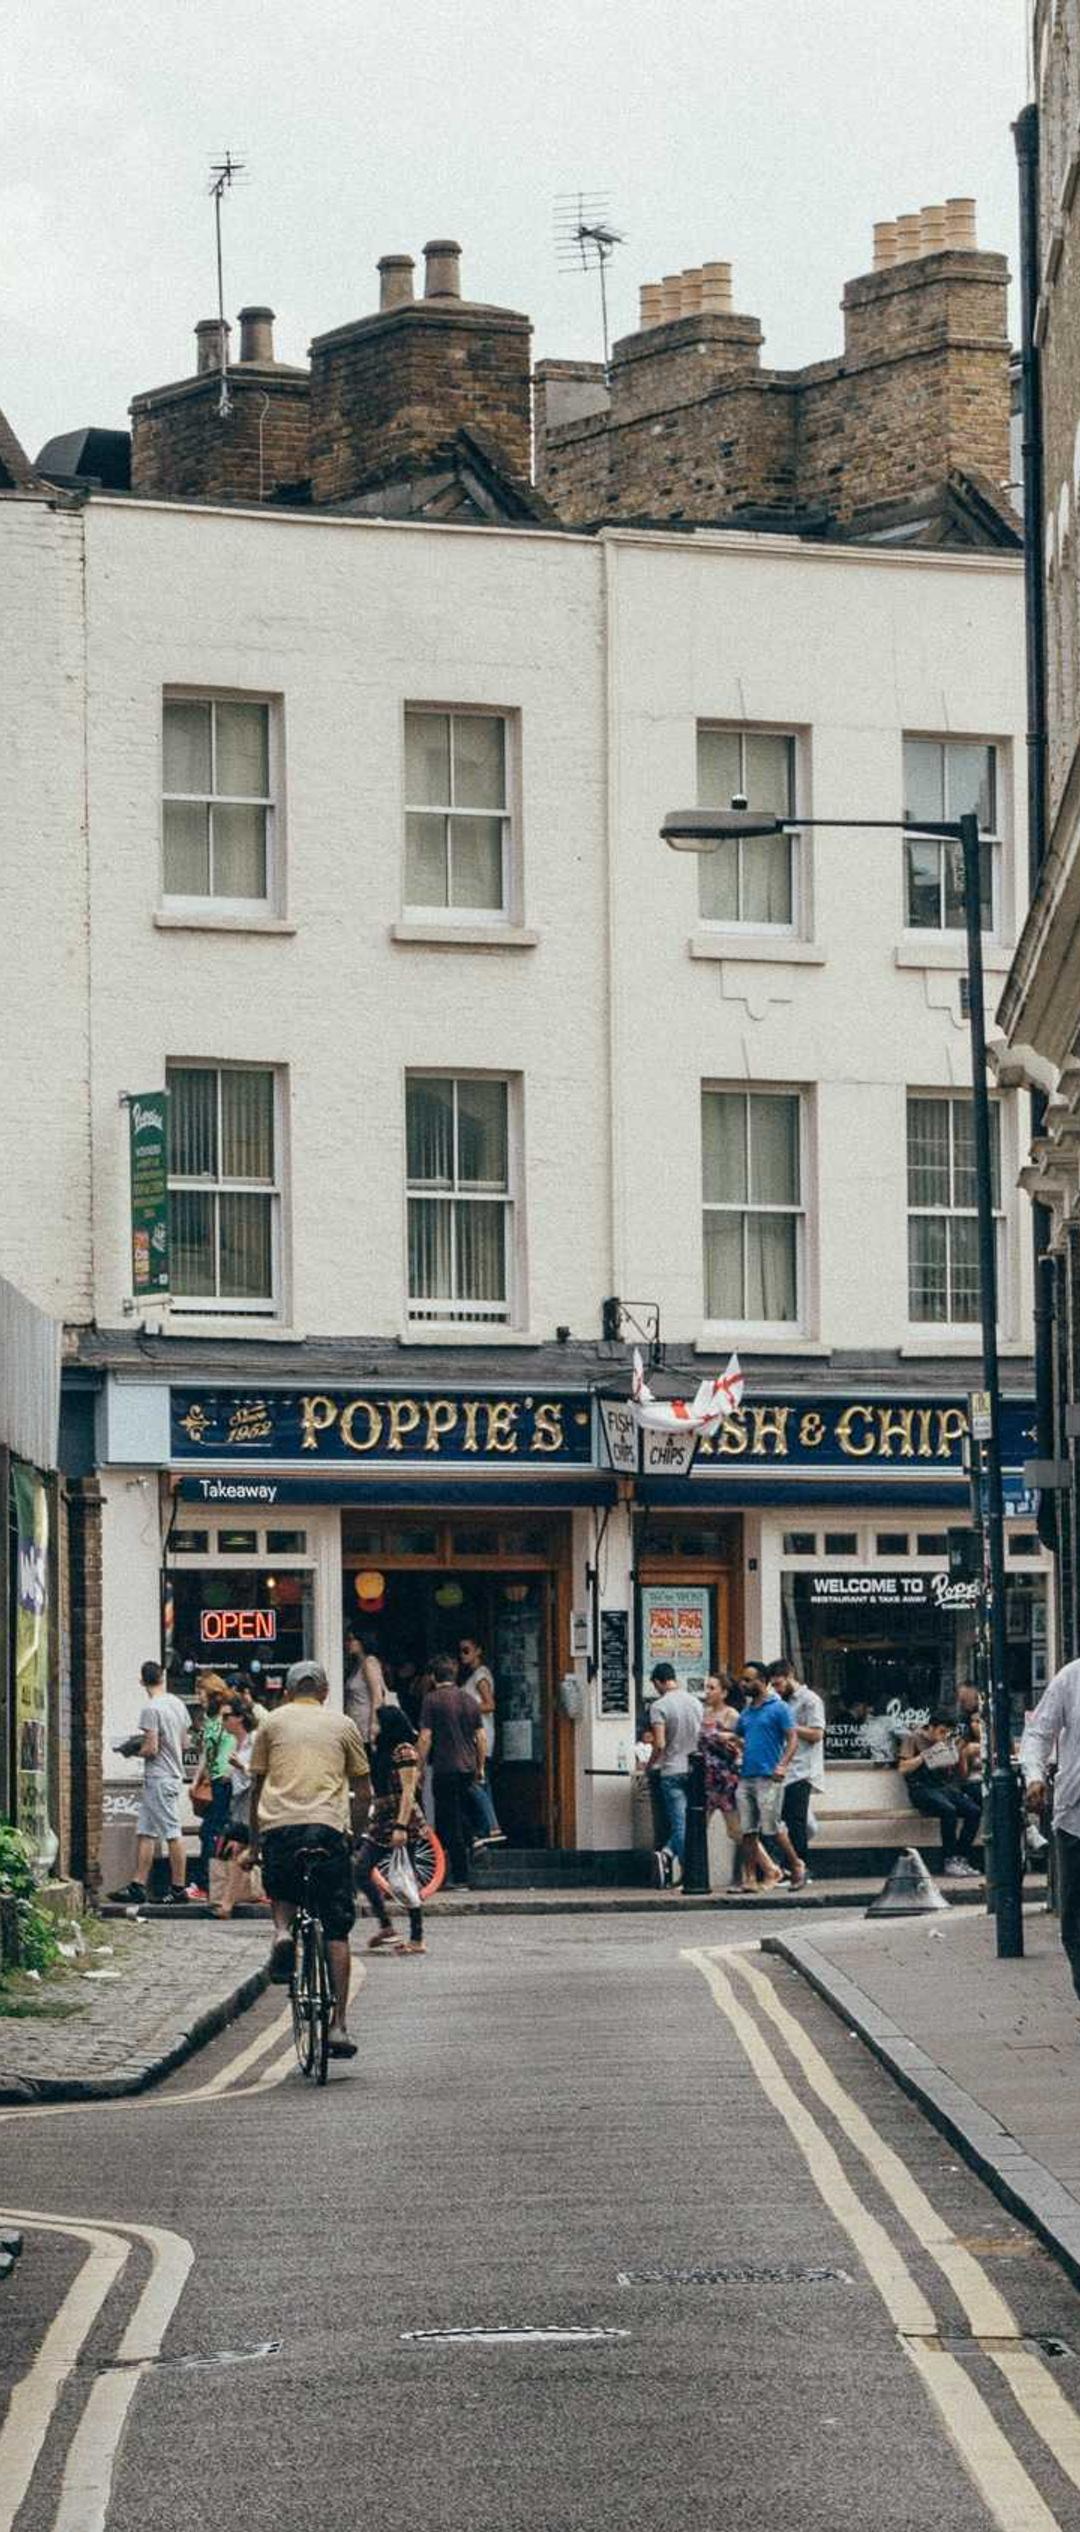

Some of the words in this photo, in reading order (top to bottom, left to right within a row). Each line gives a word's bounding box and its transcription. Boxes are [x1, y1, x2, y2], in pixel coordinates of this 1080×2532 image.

[302, 1395, 565, 1453] POPPIE'S
[607, 1411, 635, 1434] FISH
[800, 1413, 826, 1447] &
[650, 1446, 685, 1465] CHIPS
[200, 1479, 277, 1504] Takeaway
[813, 1578, 897, 1594] WELCOME
[901, 1578, 924, 1594] TO
[810, 1596, 868, 1604] RESTAURANT
[878, 1596, 900, 1604] TAKE
[902, 1596, 928, 1604] AWAY
[203, 1612, 273, 1639] OPEN
